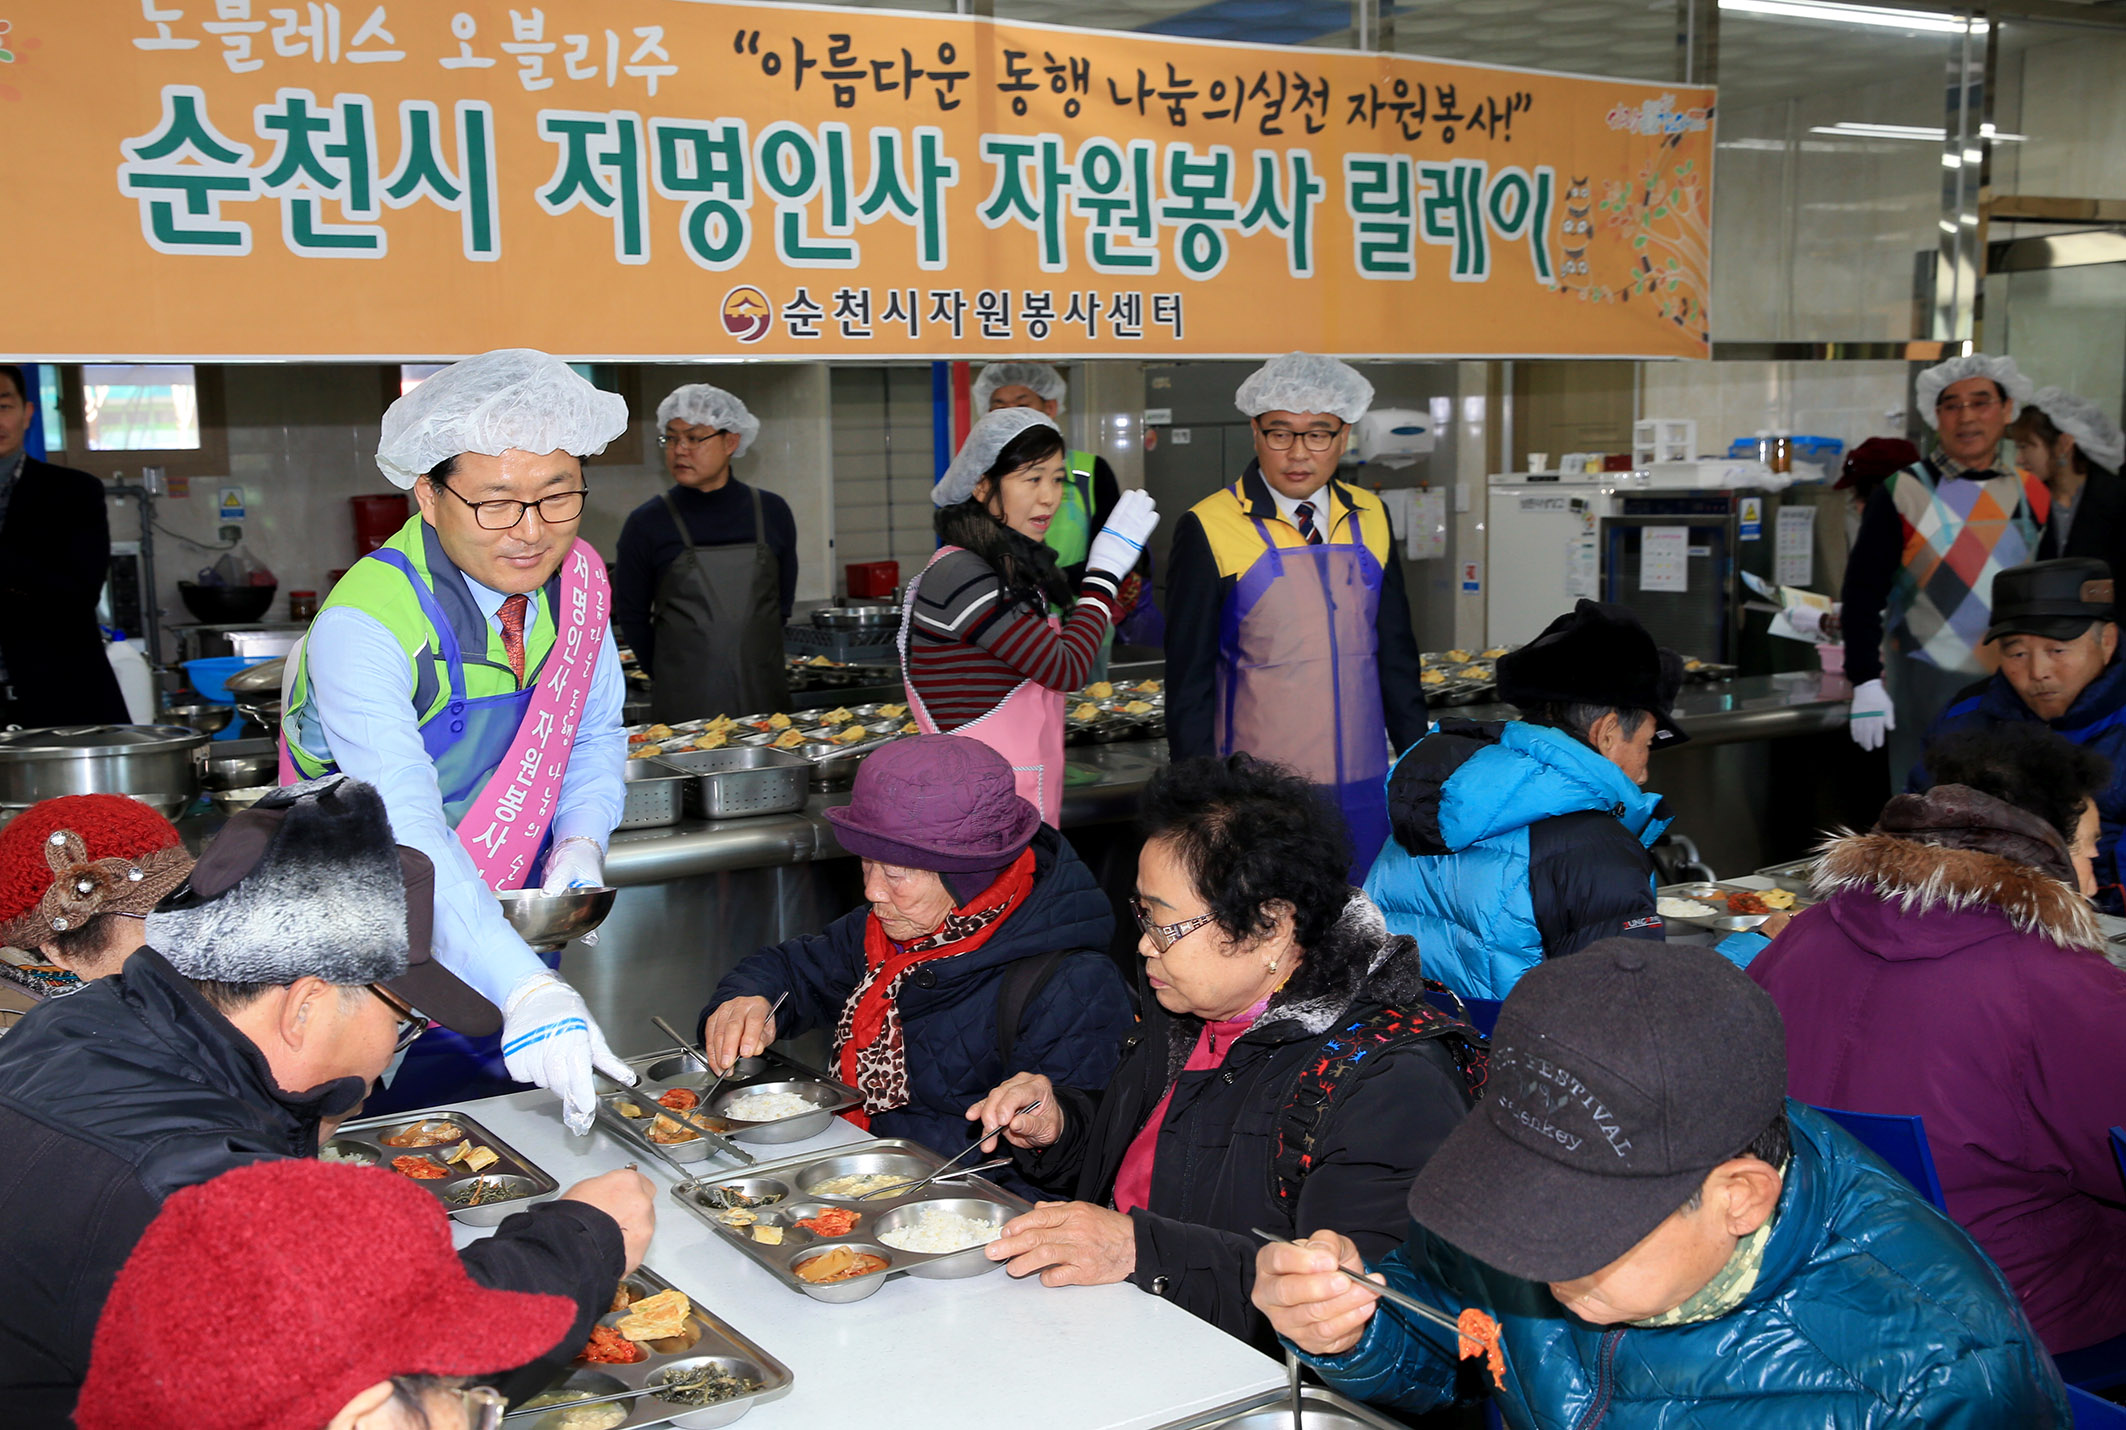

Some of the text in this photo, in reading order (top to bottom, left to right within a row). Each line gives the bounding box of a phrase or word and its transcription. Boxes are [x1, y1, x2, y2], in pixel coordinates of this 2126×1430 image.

[131, 0, 679, 97] 노블레스 오블리주
[996, 49, 1090, 118] 동행
[122, 90, 1553, 281] 순천시 저명인사 자원봉사 릴레이
[782, 288, 1184, 340] 순천시자원봉사센터
[583, 567, 608, 678] 아름다운
[472, 549, 589, 859] 저명인사 자원봉사
[560, 689, 581, 746] 동행
[524, 762, 562, 839] 나눔의
